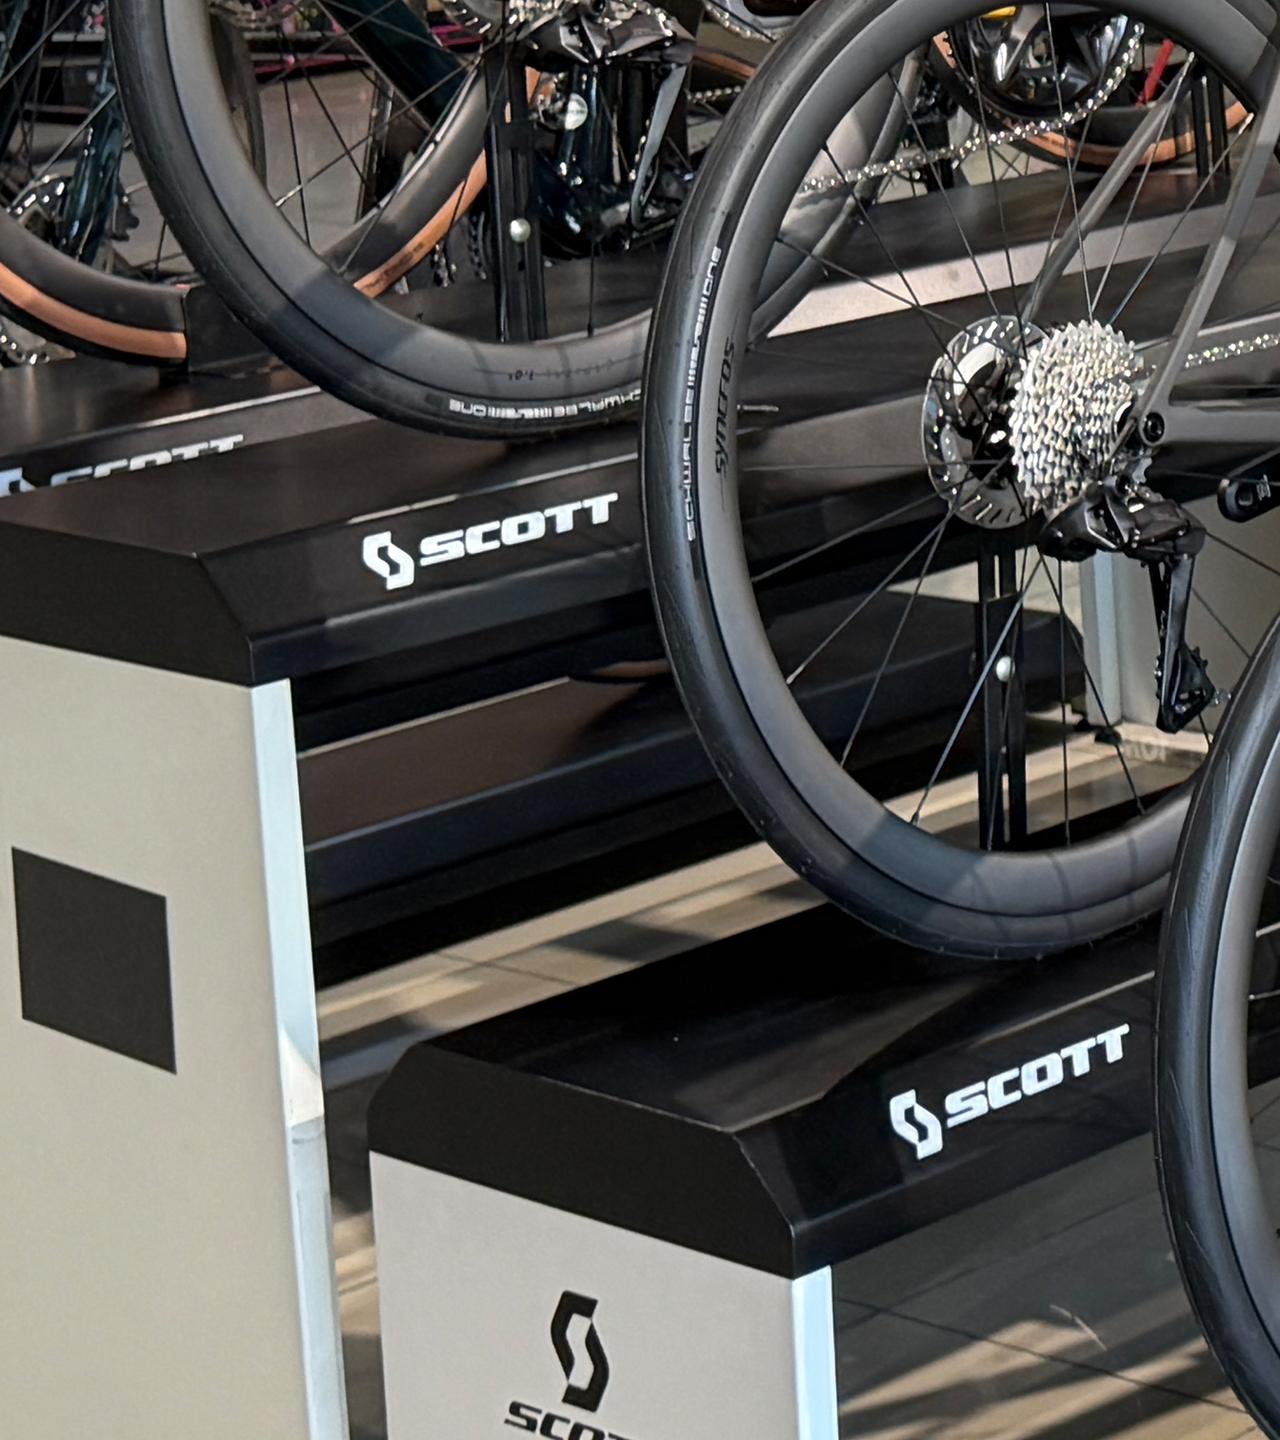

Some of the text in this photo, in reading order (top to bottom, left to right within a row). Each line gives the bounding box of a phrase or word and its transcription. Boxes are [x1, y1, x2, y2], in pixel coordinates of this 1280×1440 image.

[551, 388, 642, 418] CHWALBE
[420, 493, 618, 567] SCOTT
[944, 1023, 1131, 1130] SCOTT
